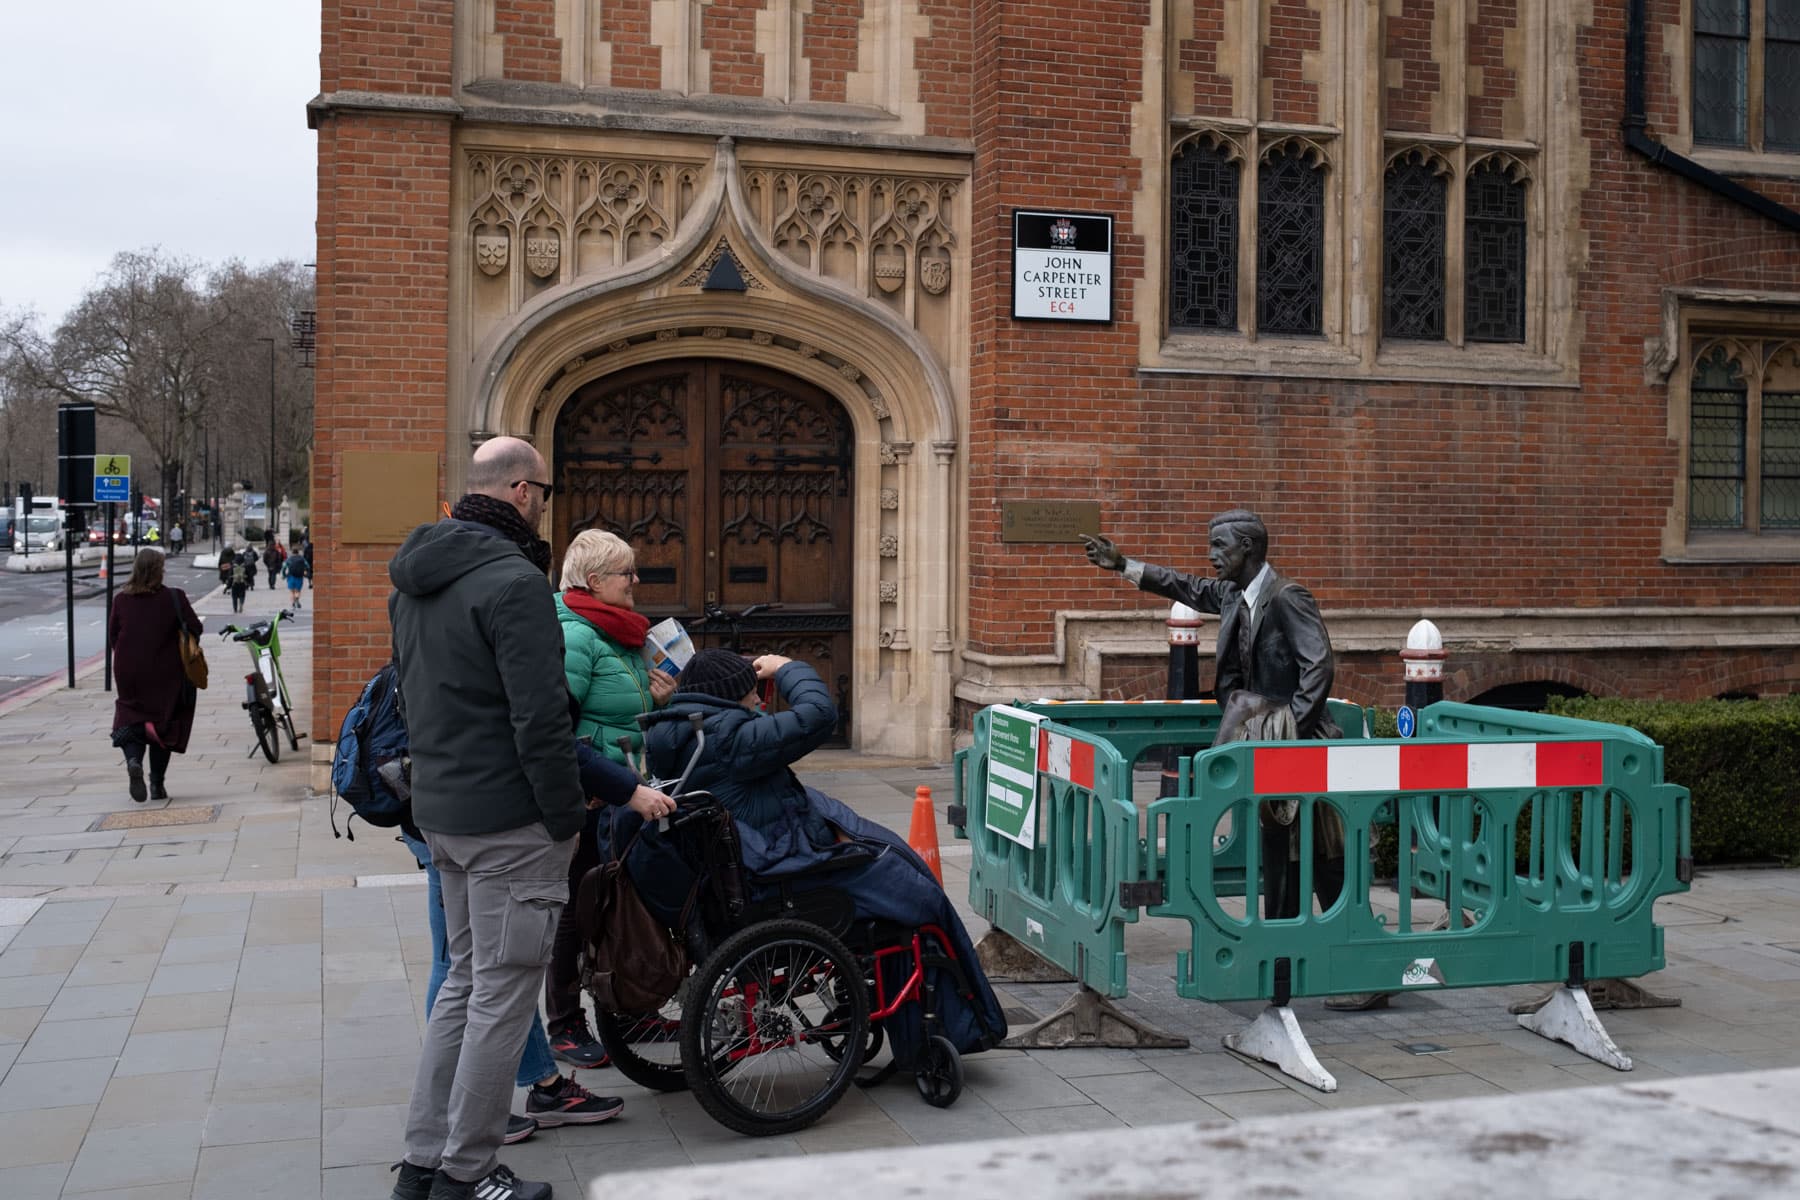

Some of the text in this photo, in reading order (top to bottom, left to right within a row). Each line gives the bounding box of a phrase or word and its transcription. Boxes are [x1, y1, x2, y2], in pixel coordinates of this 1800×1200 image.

[1045, 257, 1082, 269] JOHN
[1023, 270, 1101, 285] CARPENTER
[1039, 286, 1087, 299] STREET
[1050, 301, 1074, 313] EC4
